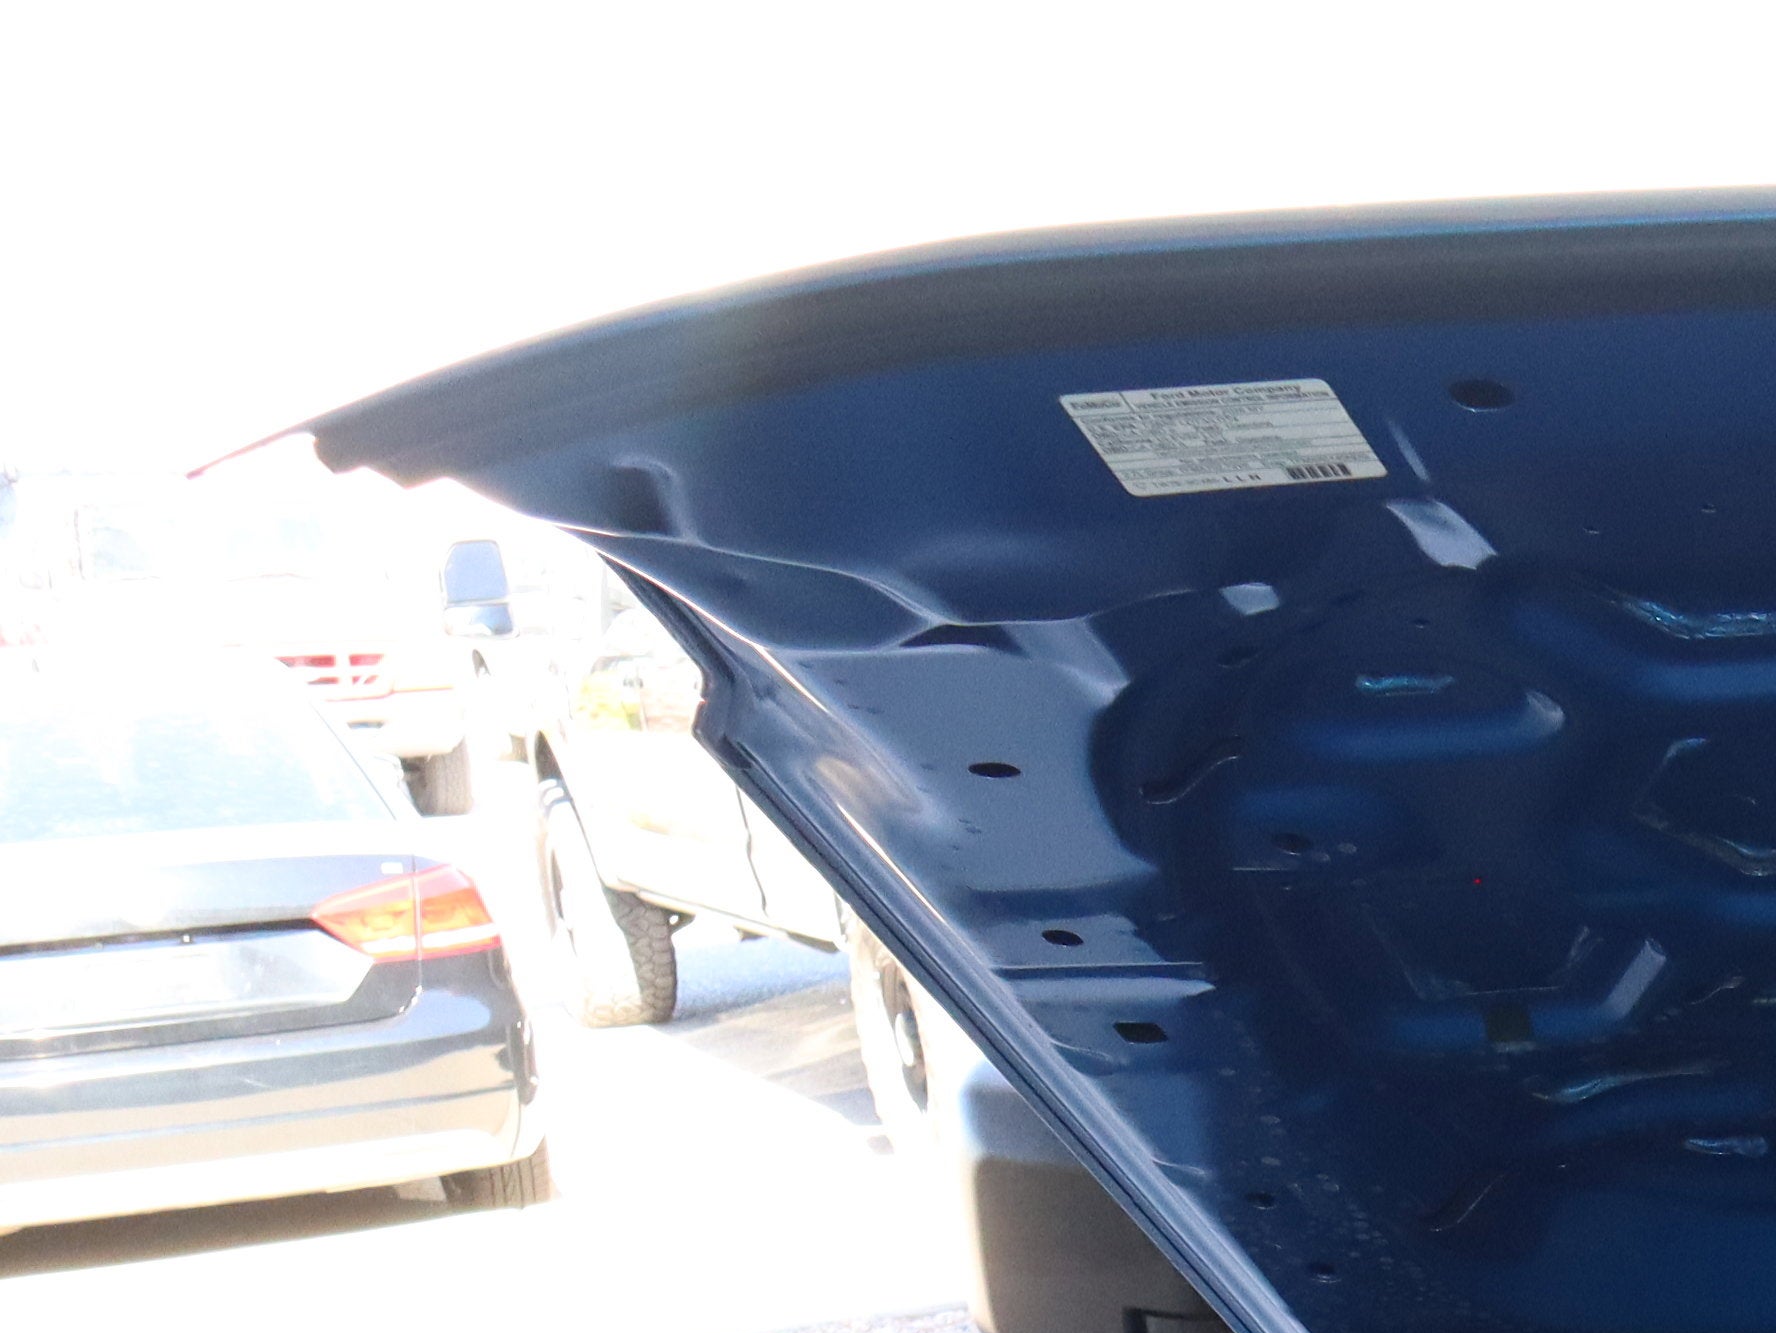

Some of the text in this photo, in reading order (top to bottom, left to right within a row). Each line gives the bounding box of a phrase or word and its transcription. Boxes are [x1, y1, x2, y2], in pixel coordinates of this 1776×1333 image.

[1149, 384, 1302, 400] Ford Motor Company
